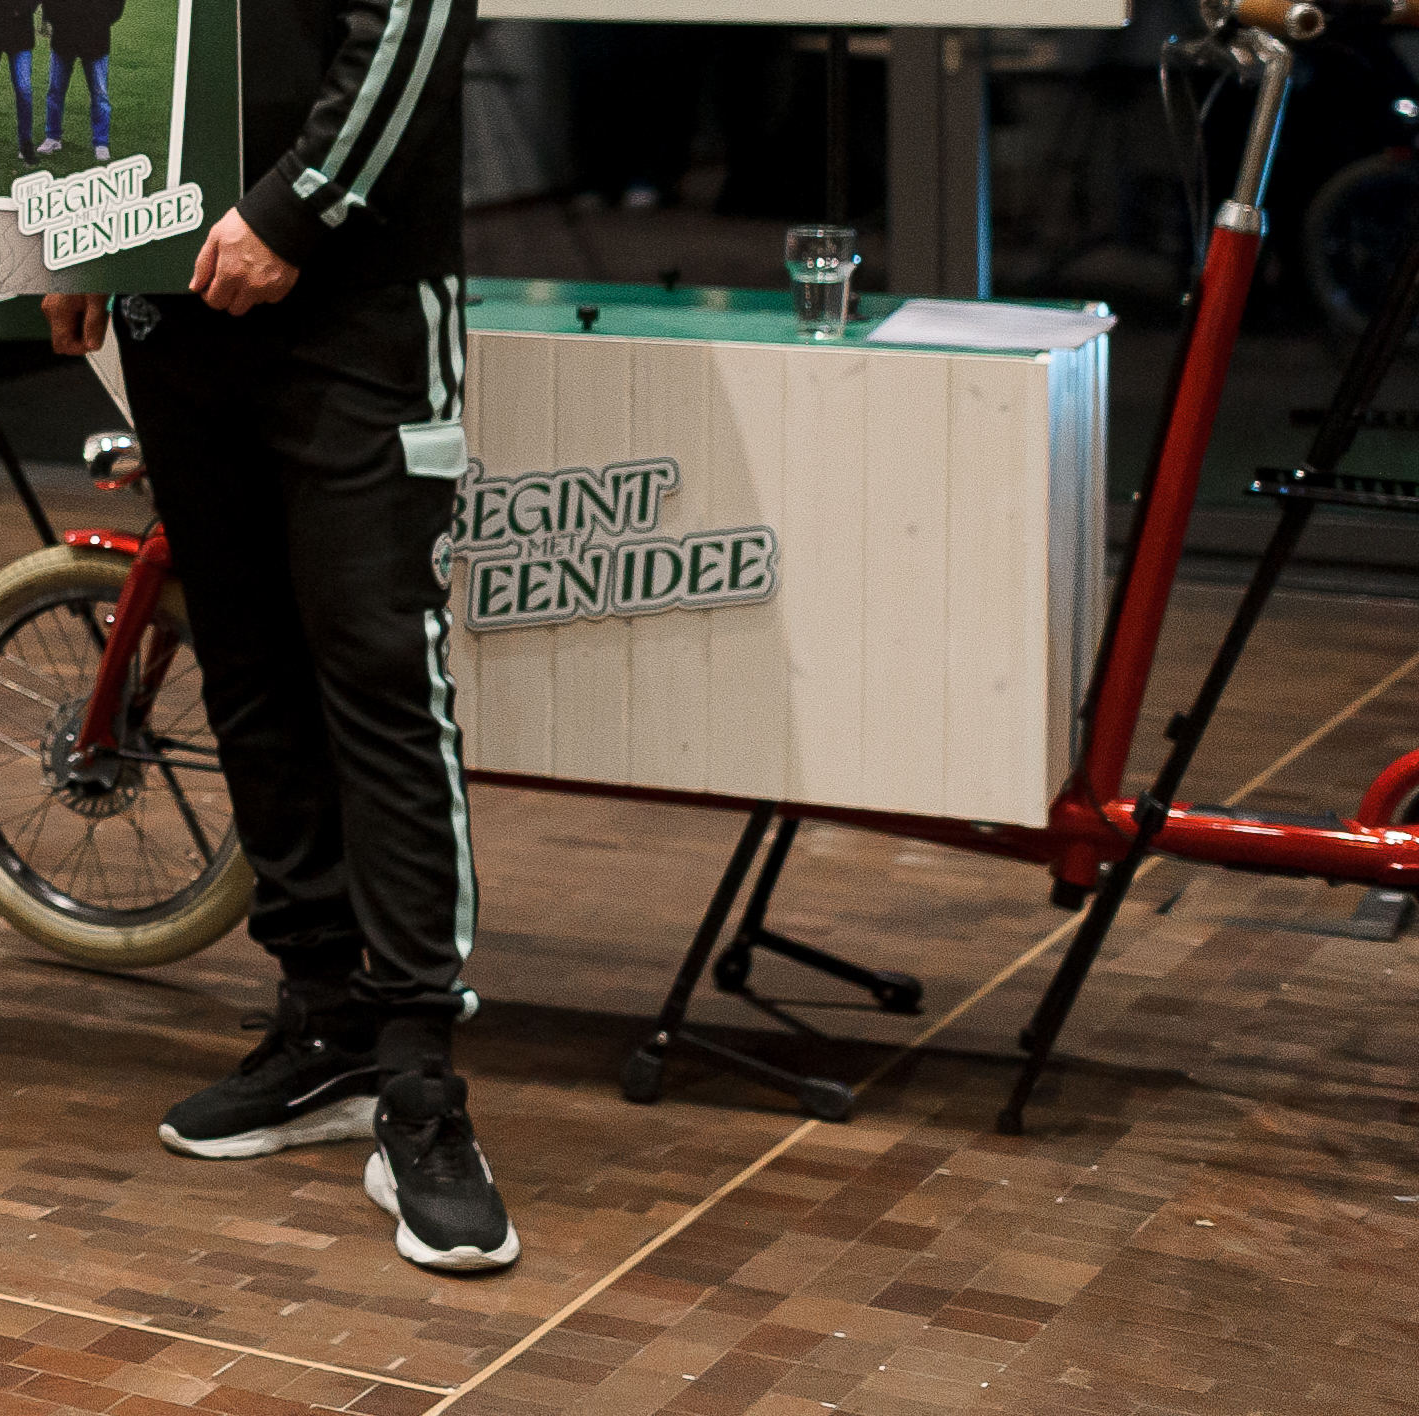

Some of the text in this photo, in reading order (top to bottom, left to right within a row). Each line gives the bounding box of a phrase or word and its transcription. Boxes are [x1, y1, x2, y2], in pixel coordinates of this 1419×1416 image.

[27, 165, 142, 225] BEGINT
[53, 216, 114, 260] EEN
[124, 193, 194, 239] IDEE
[527, 531, 582, 559] MET
[477, 537, 765, 619] EEN IDEE
